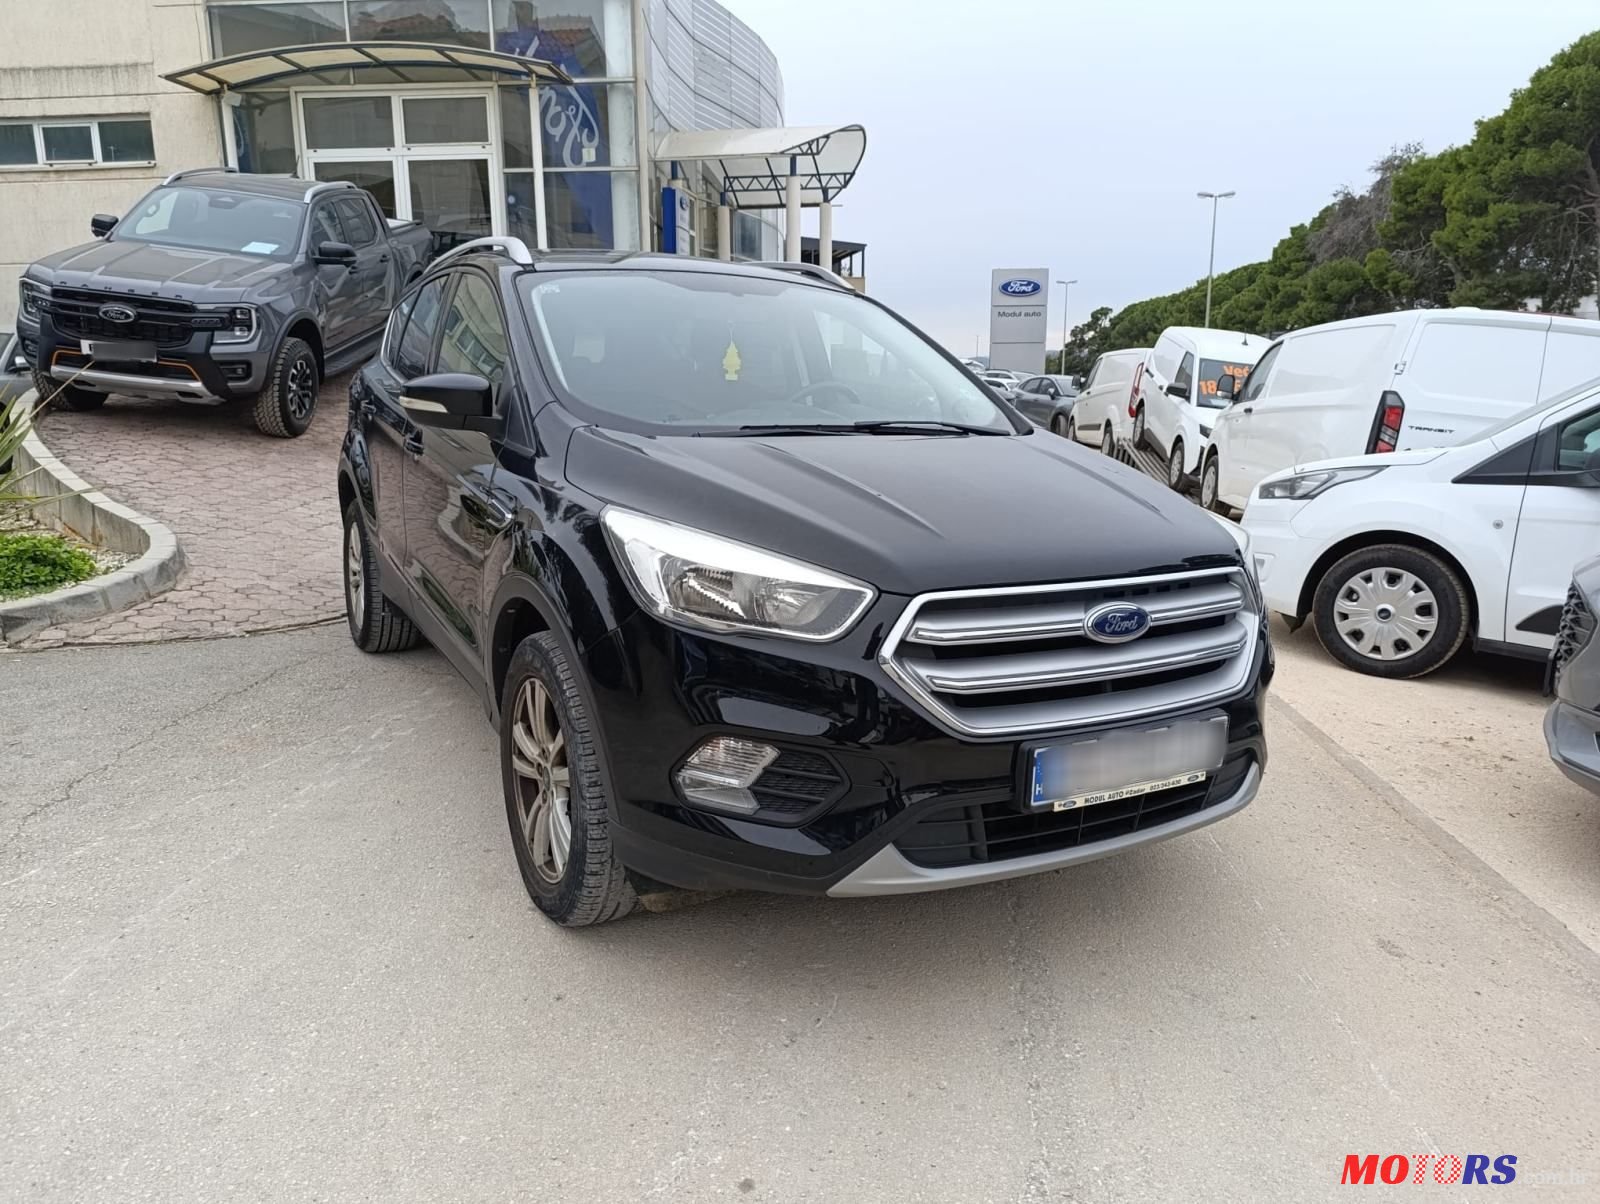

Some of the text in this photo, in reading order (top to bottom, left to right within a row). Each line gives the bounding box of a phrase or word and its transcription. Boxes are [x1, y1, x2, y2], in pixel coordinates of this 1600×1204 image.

[1007, 280, 1035, 292] Ford
[1104, 612, 1138, 633] Ford
[1084, 794, 1106, 804] MODUL
[1107, 791, 1124, 800] AUTO
